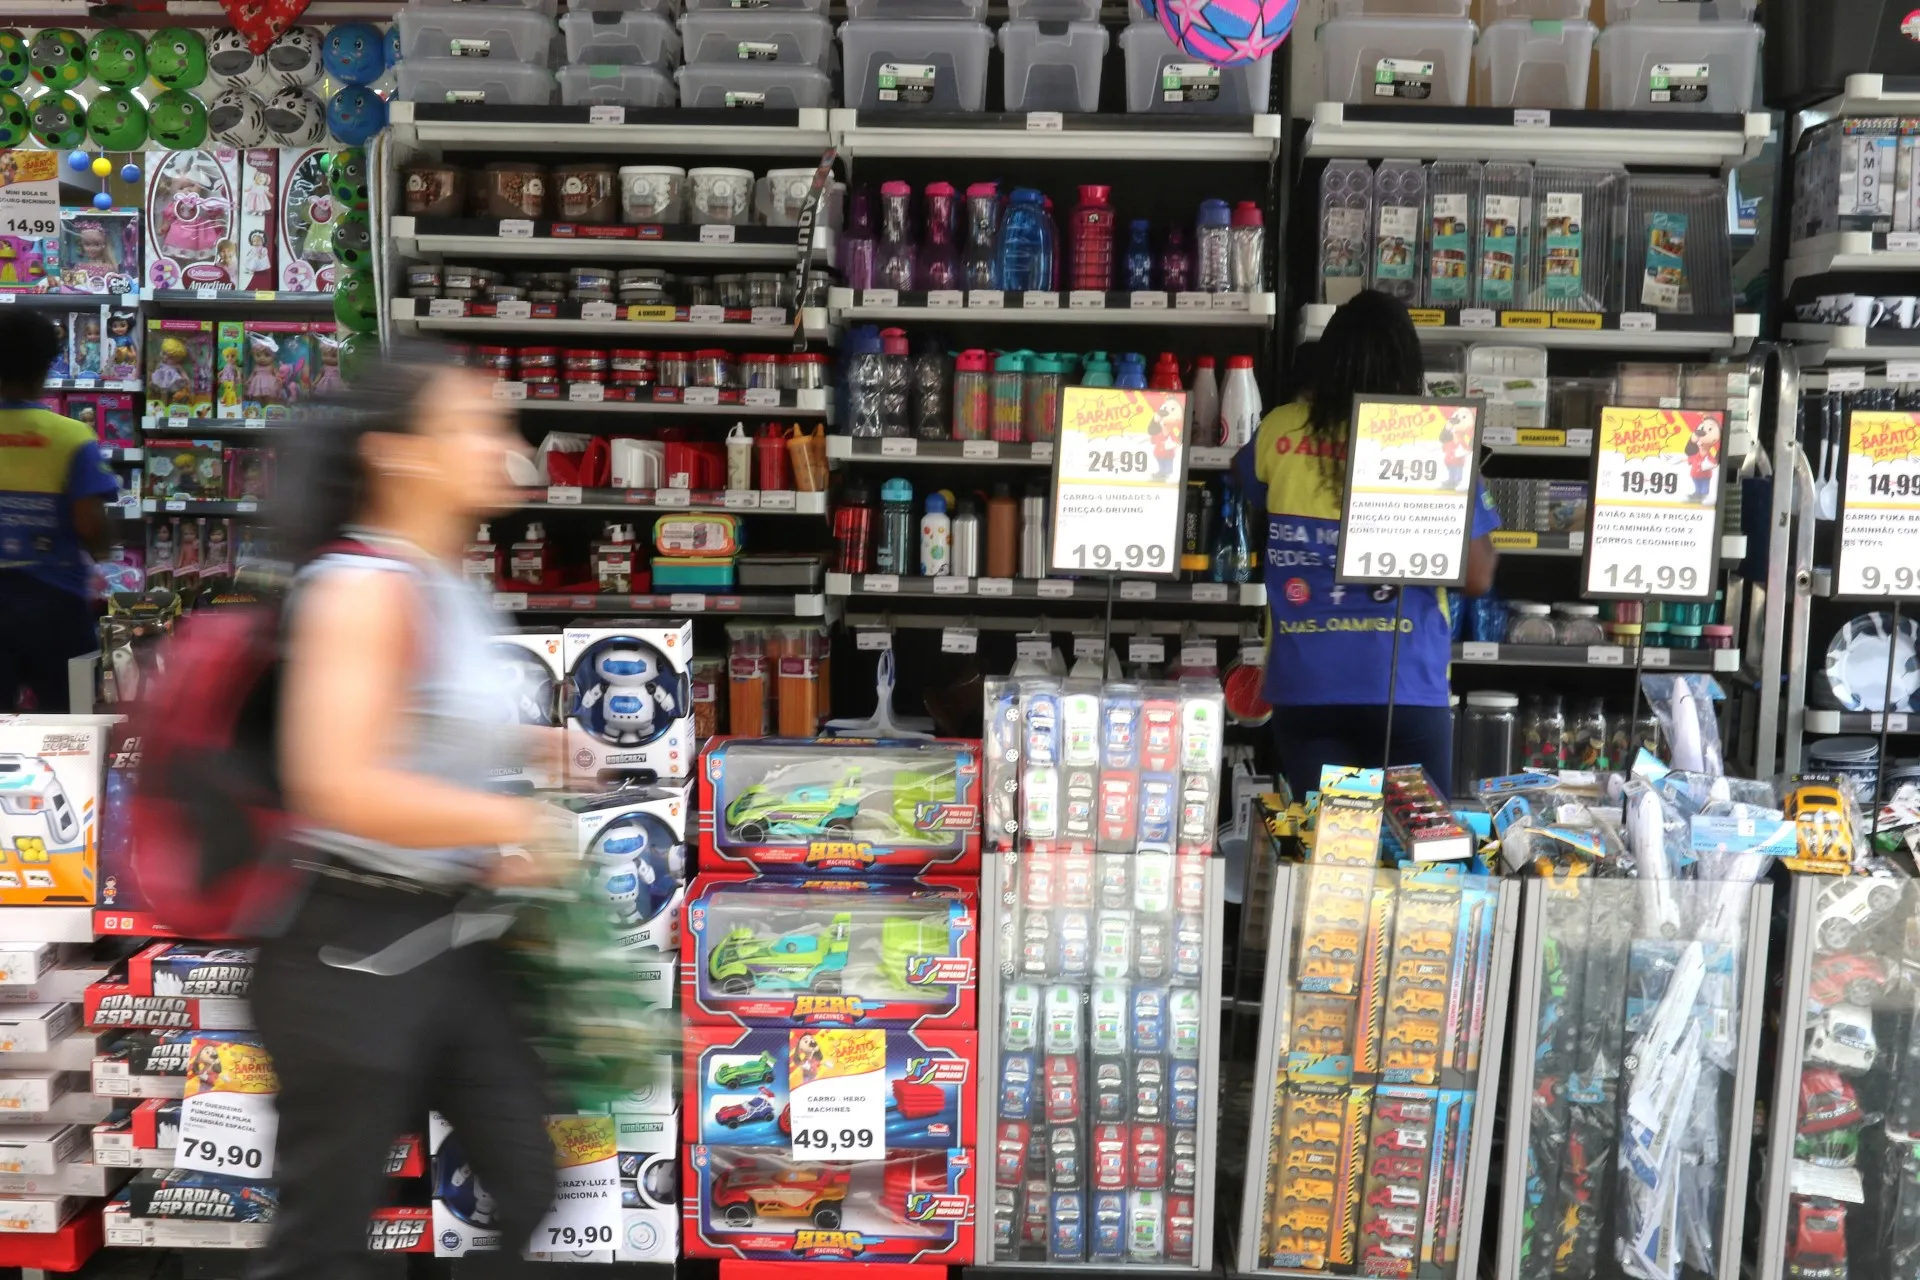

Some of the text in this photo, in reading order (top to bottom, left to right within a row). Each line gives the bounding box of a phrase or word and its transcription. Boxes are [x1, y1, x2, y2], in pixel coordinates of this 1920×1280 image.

[1863, 140, 1875, 202] AMOR
[7, 219, 55, 235] 14,99
[1076, 404, 1132, 427] BARATO
[1370, 413, 1424, 435] BARATO
[1614, 423, 1669, 446] BARATO
[1862, 427, 1916, 449] BARATO
[1088, 451, 1148, 475] 24,99
[1379, 458, 1438, 482] 24,99
[1620, 471, 1679, 496] 19,99
[1403, 502, 1456, 510] BOMBEIROS
[1269, 522, 1309, 543] SIGA
[1072, 544, 1166, 571] 19,99
[1267, 548, 1322, 567] REDES
[1358, 552, 1449, 578] 19,99
[1604, 564, 1698, 594] 14,99
[1862, 566, 1920, 595] 9,9
[807, 842, 875, 862] HERO
[794, 996, 865, 1015] HERO
[93, 1010, 192, 1028] ESPACIAL
[835, 1040, 876, 1058] BARATO
[190, 1108, 224, 1120] FUNCIONA
[232, 1115, 252, 1124] PILHA
[205, 1102, 243, 1113] GUERREIRO
[225, 1122, 257, 1132] ESPACIAL
[566, 1130, 607, 1146] BARATO
[794, 1128, 874, 1154] 49,99
[183, 1137, 262, 1169] 79,90
[154, 1188, 231, 1202] GUARDIÃO
[556, 1192, 599, 1200] UNCIONA
[147, 1201, 236, 1218] ESPACIAL
[548, 1225, 613, 1248] 79,90
[794, 1230, 865, 1250] HERO
